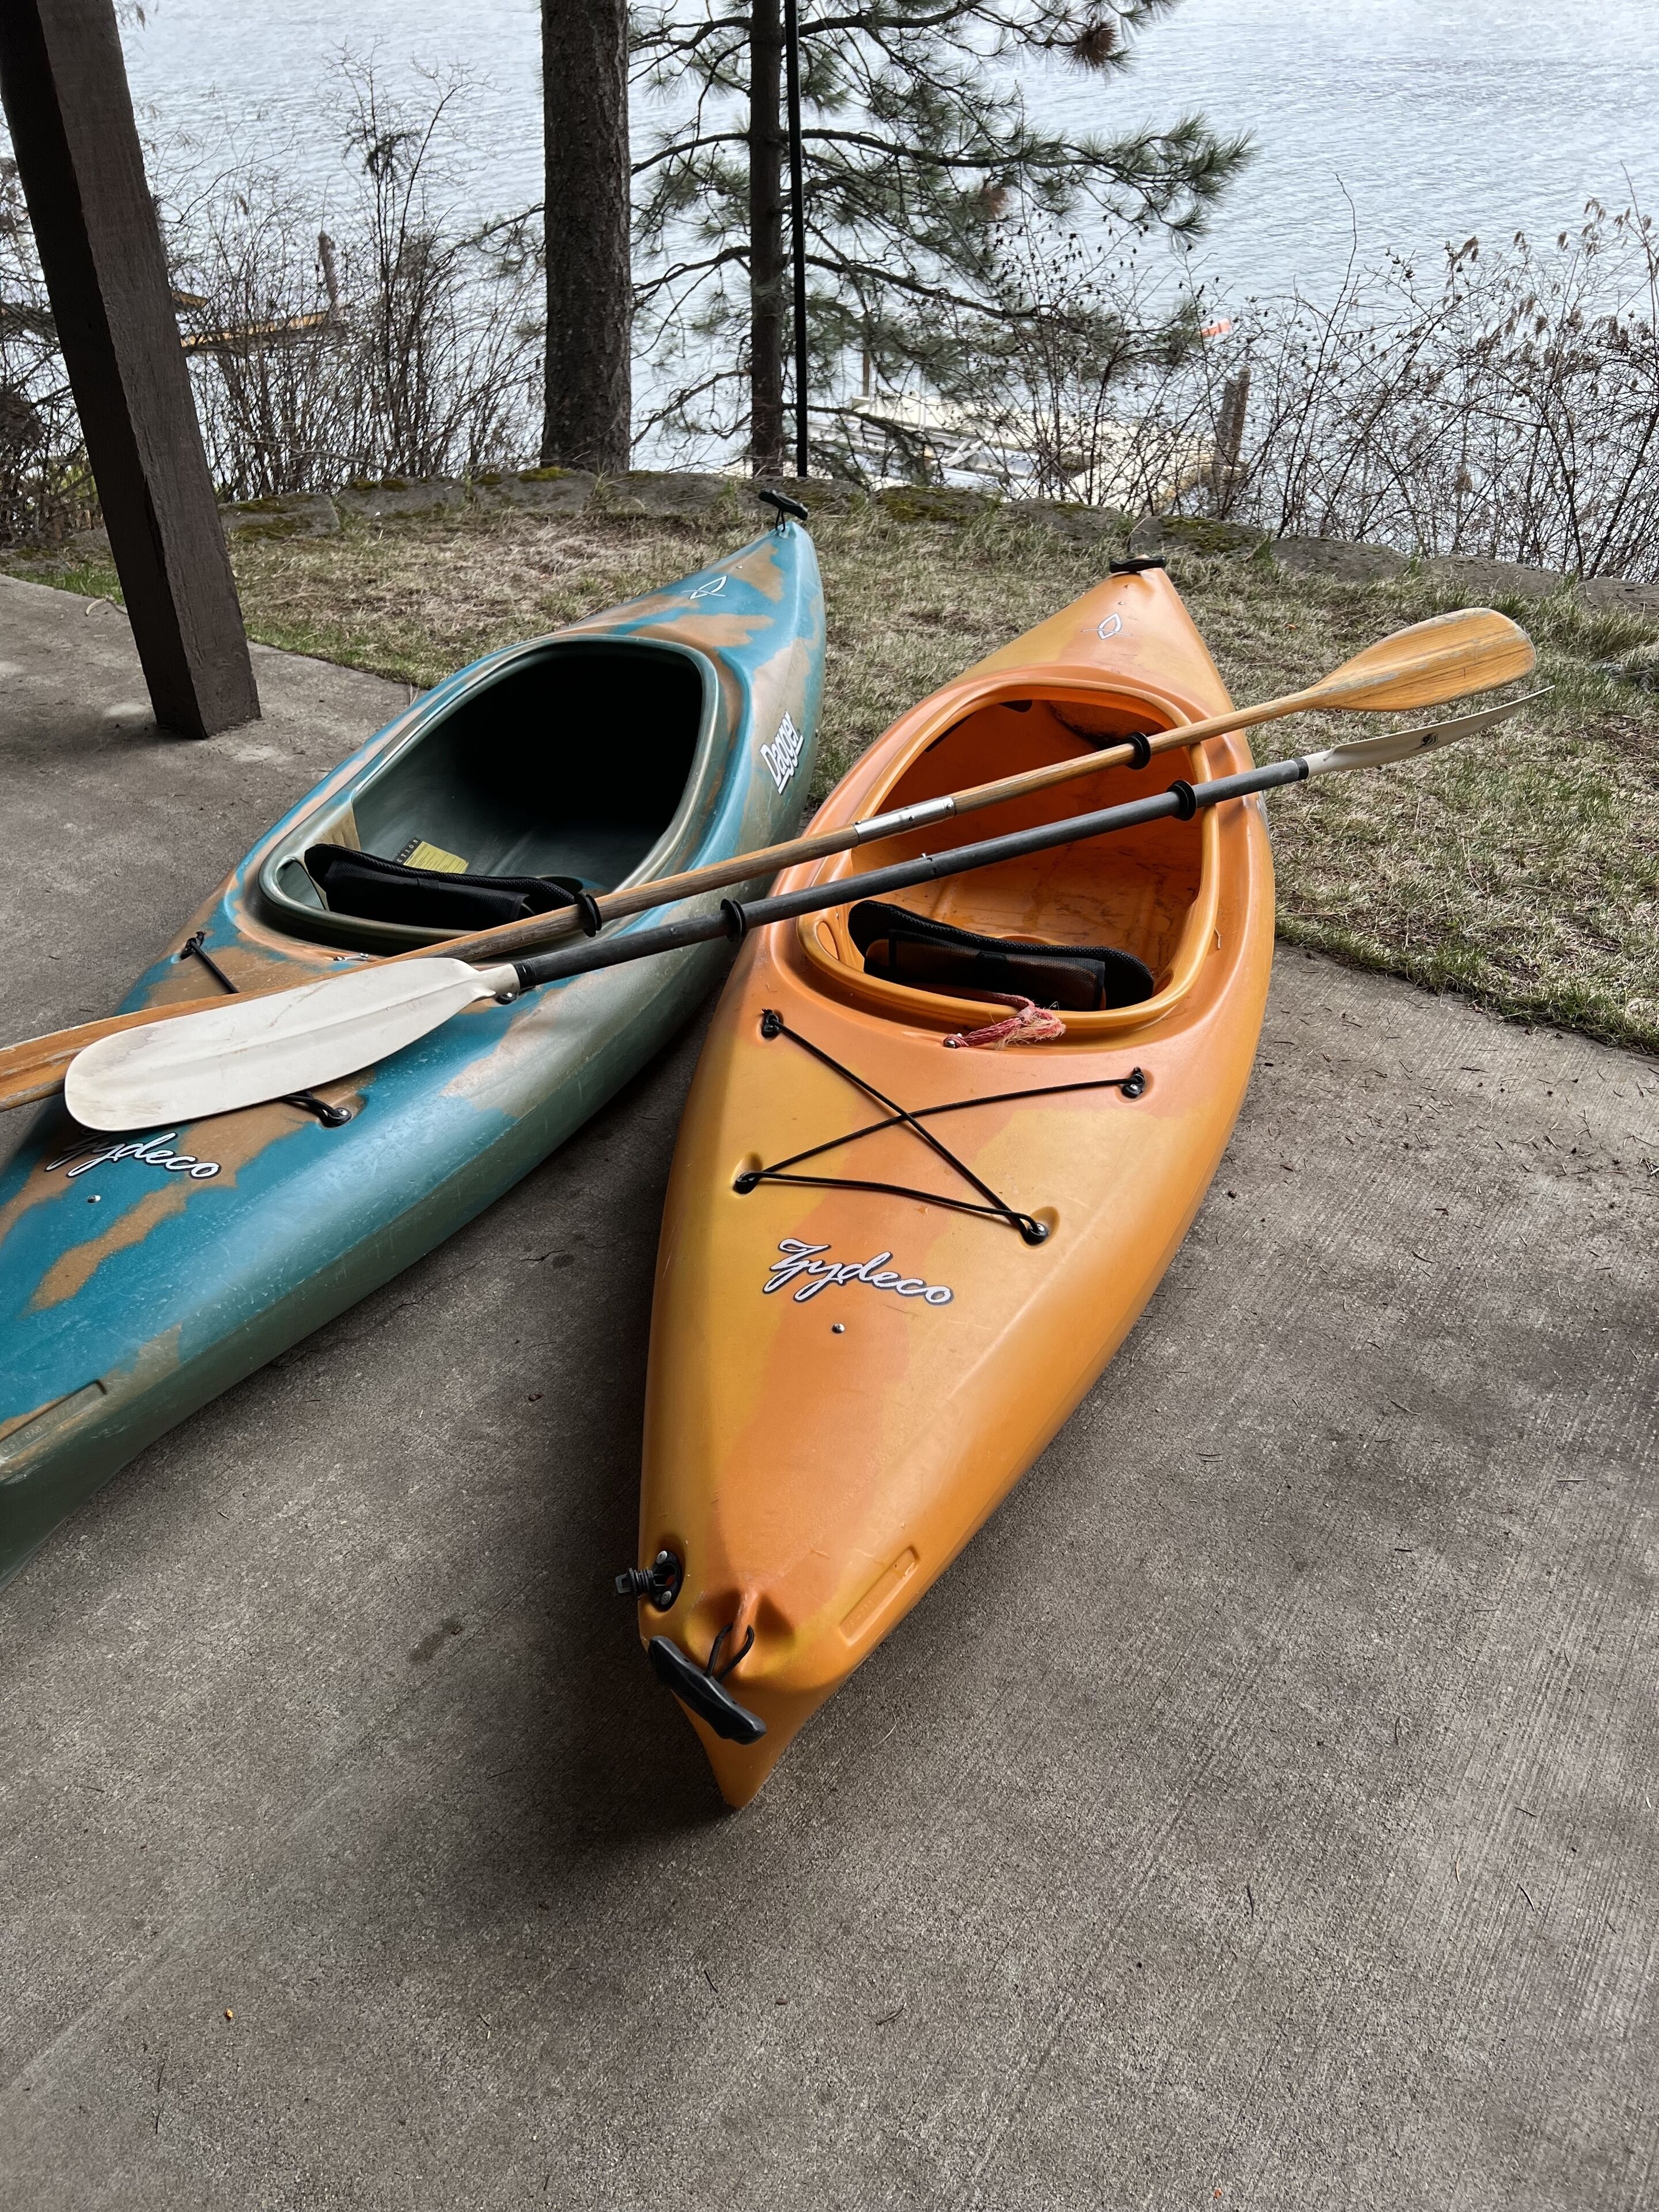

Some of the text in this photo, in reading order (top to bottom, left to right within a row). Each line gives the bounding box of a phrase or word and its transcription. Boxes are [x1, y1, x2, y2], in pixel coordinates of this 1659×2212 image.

[760, 710, 804, 796] Dagger
[44, 1128, 221, 1179] Zydeco
[762, 1237, 955, 1306] Zydeco
